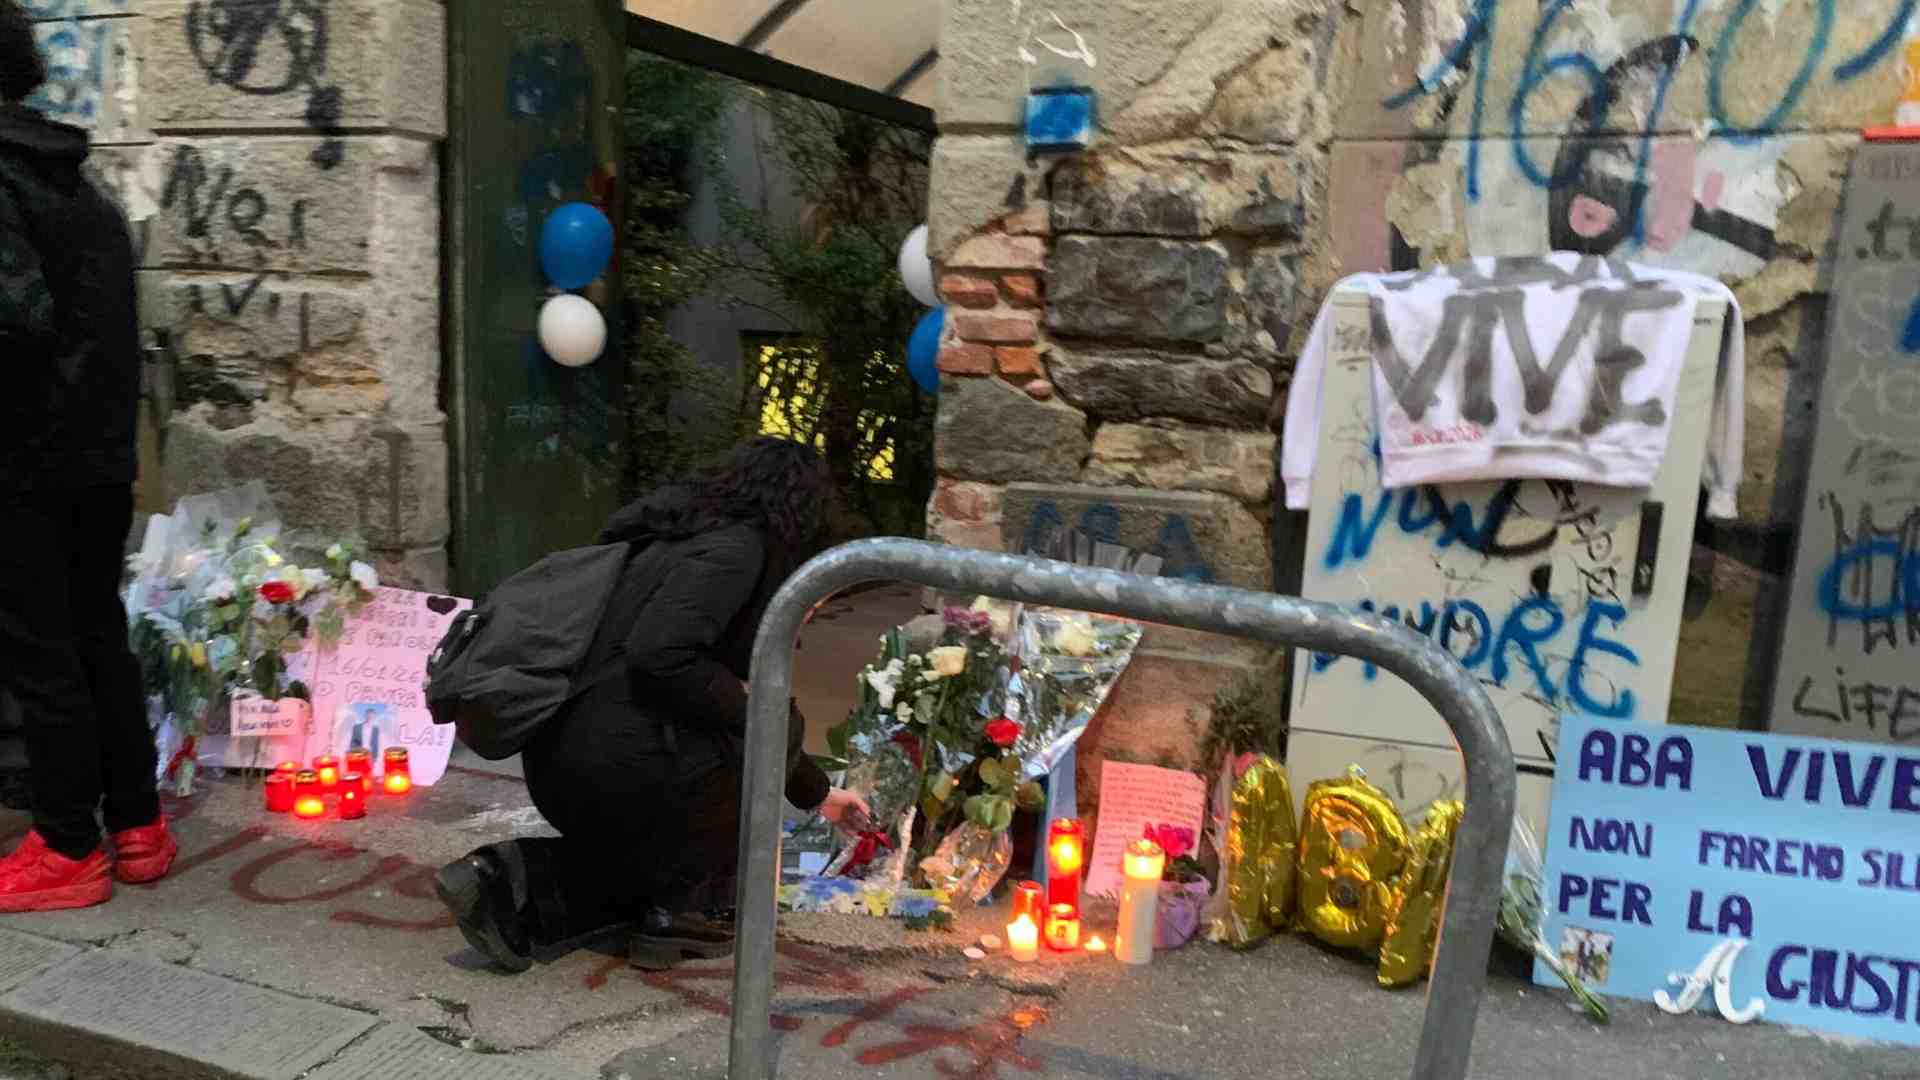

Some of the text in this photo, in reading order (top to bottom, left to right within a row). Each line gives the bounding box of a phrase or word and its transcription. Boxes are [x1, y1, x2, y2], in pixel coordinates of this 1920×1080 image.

[1369, 288, 1685, 436] VIVE
[1311, 597, 1640, 718] UORE
[1578, 729, 1920, 814] ABA VIVE
[1568, 816, 1920, 891] NON FAREMO SIL
[1557, 872, 1754, 938] PER LA
